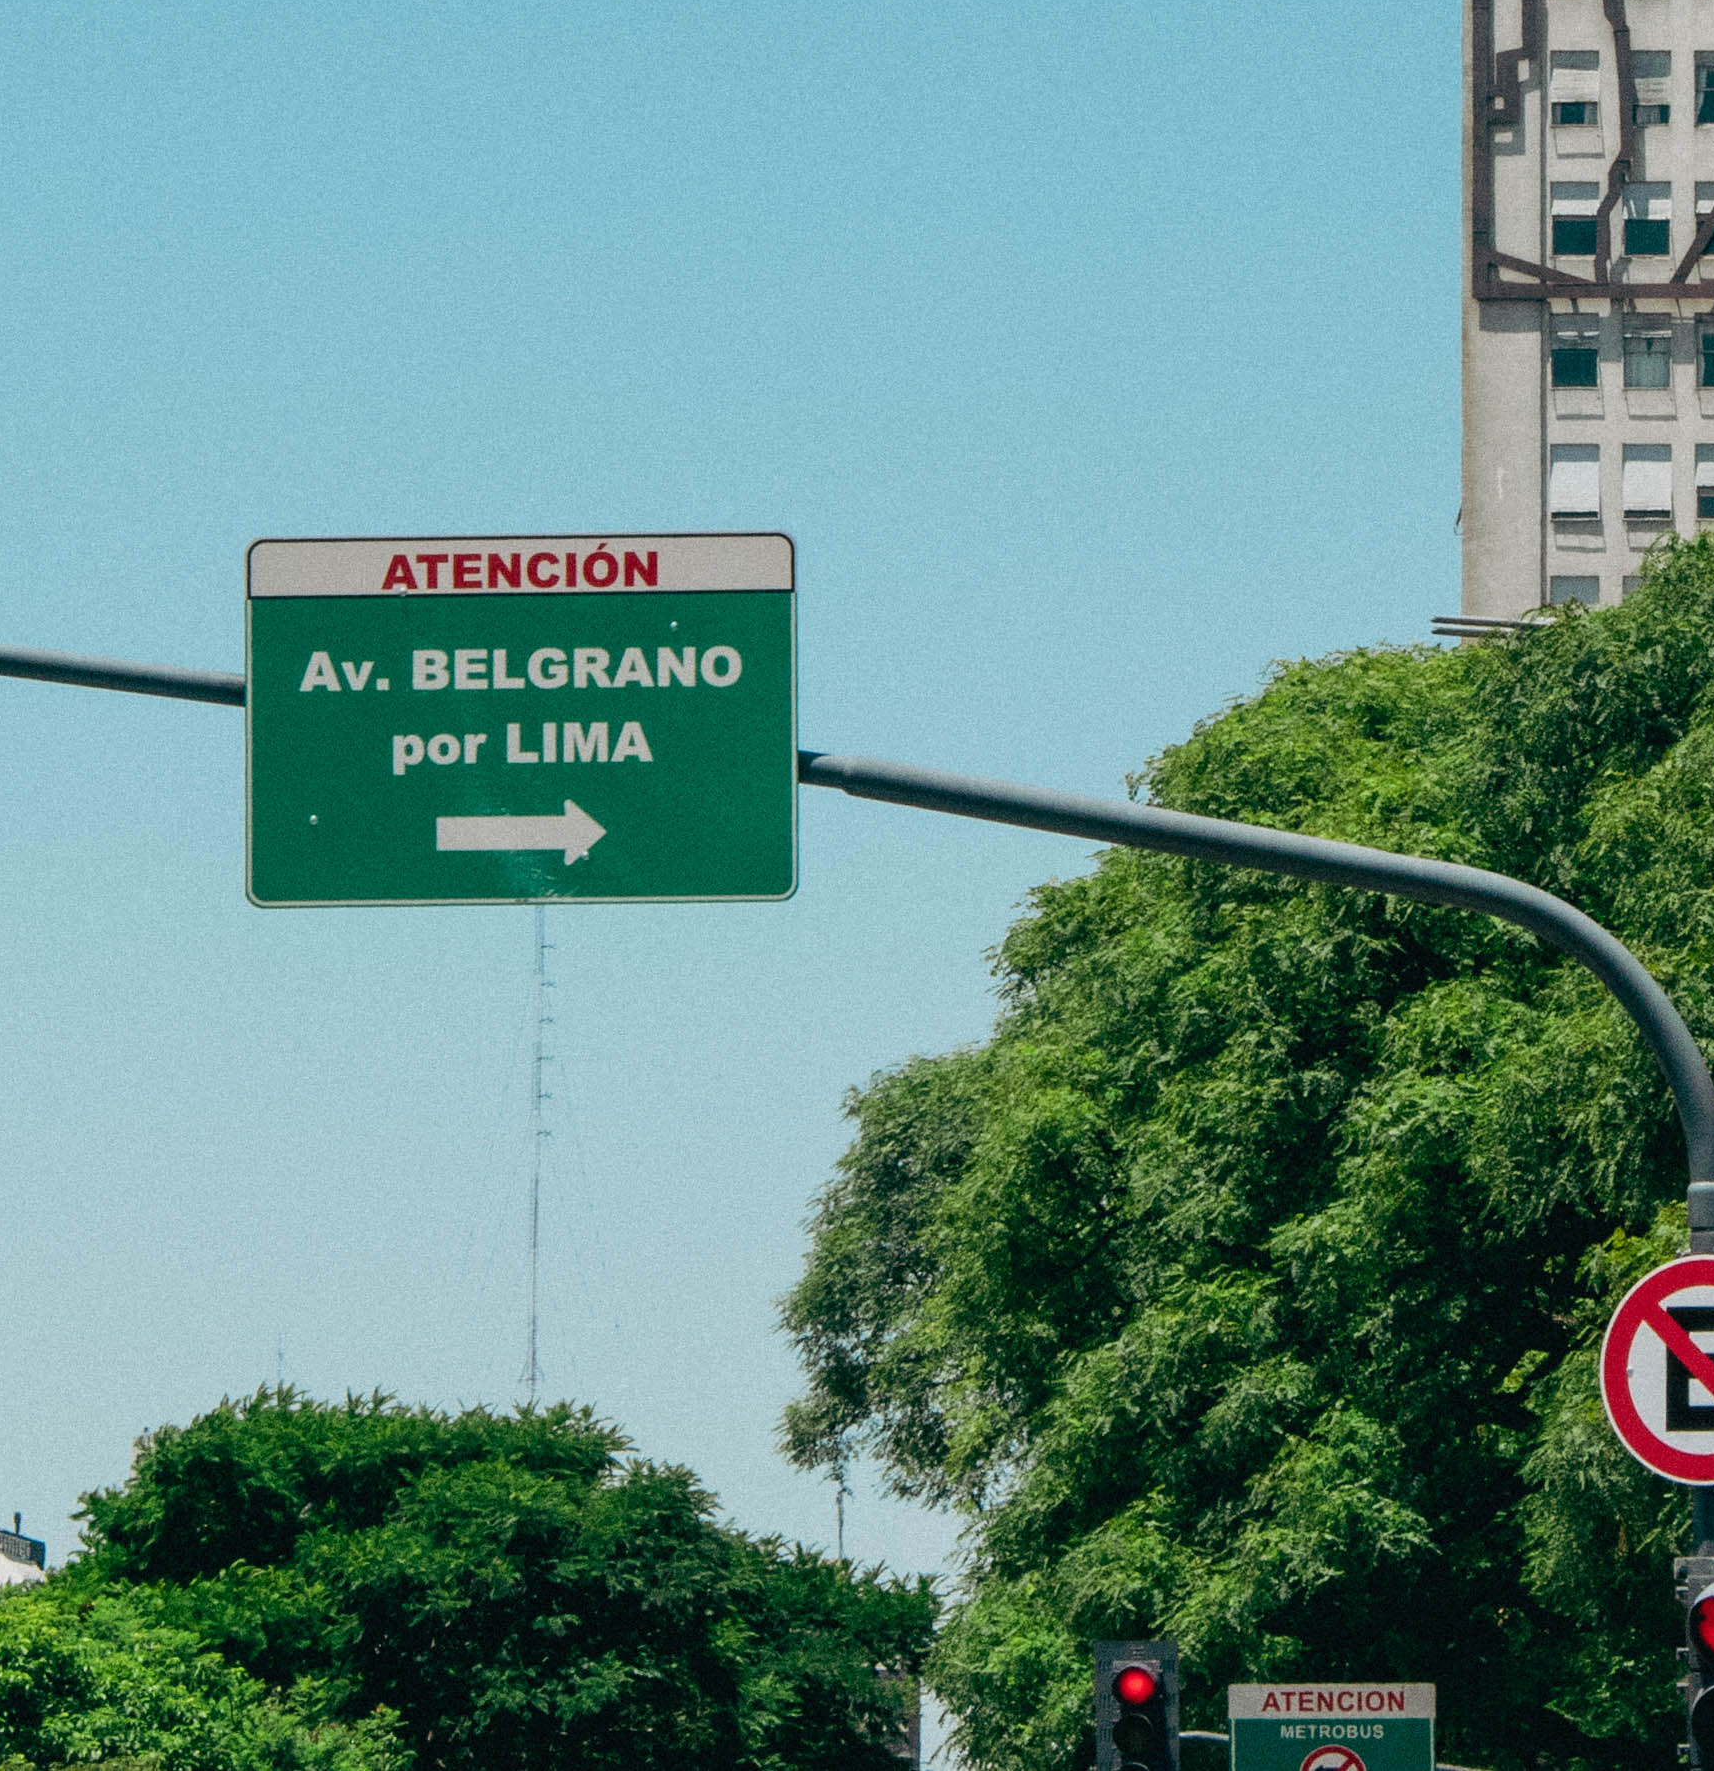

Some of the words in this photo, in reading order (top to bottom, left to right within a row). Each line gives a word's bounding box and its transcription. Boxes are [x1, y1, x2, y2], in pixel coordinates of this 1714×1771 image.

[381, 543, 658, 590] ATENCIÓN
[300, 651, 390, 692] Av.
[412, 645, 743, 690] BELGRANO
[392, 733, 488, 776] por
[506, 721, 653, 764] LIMA
[1261, 1691, 1405, 1712] ATENCION
[1280, 1724, 1385, 1739] METROBUS
